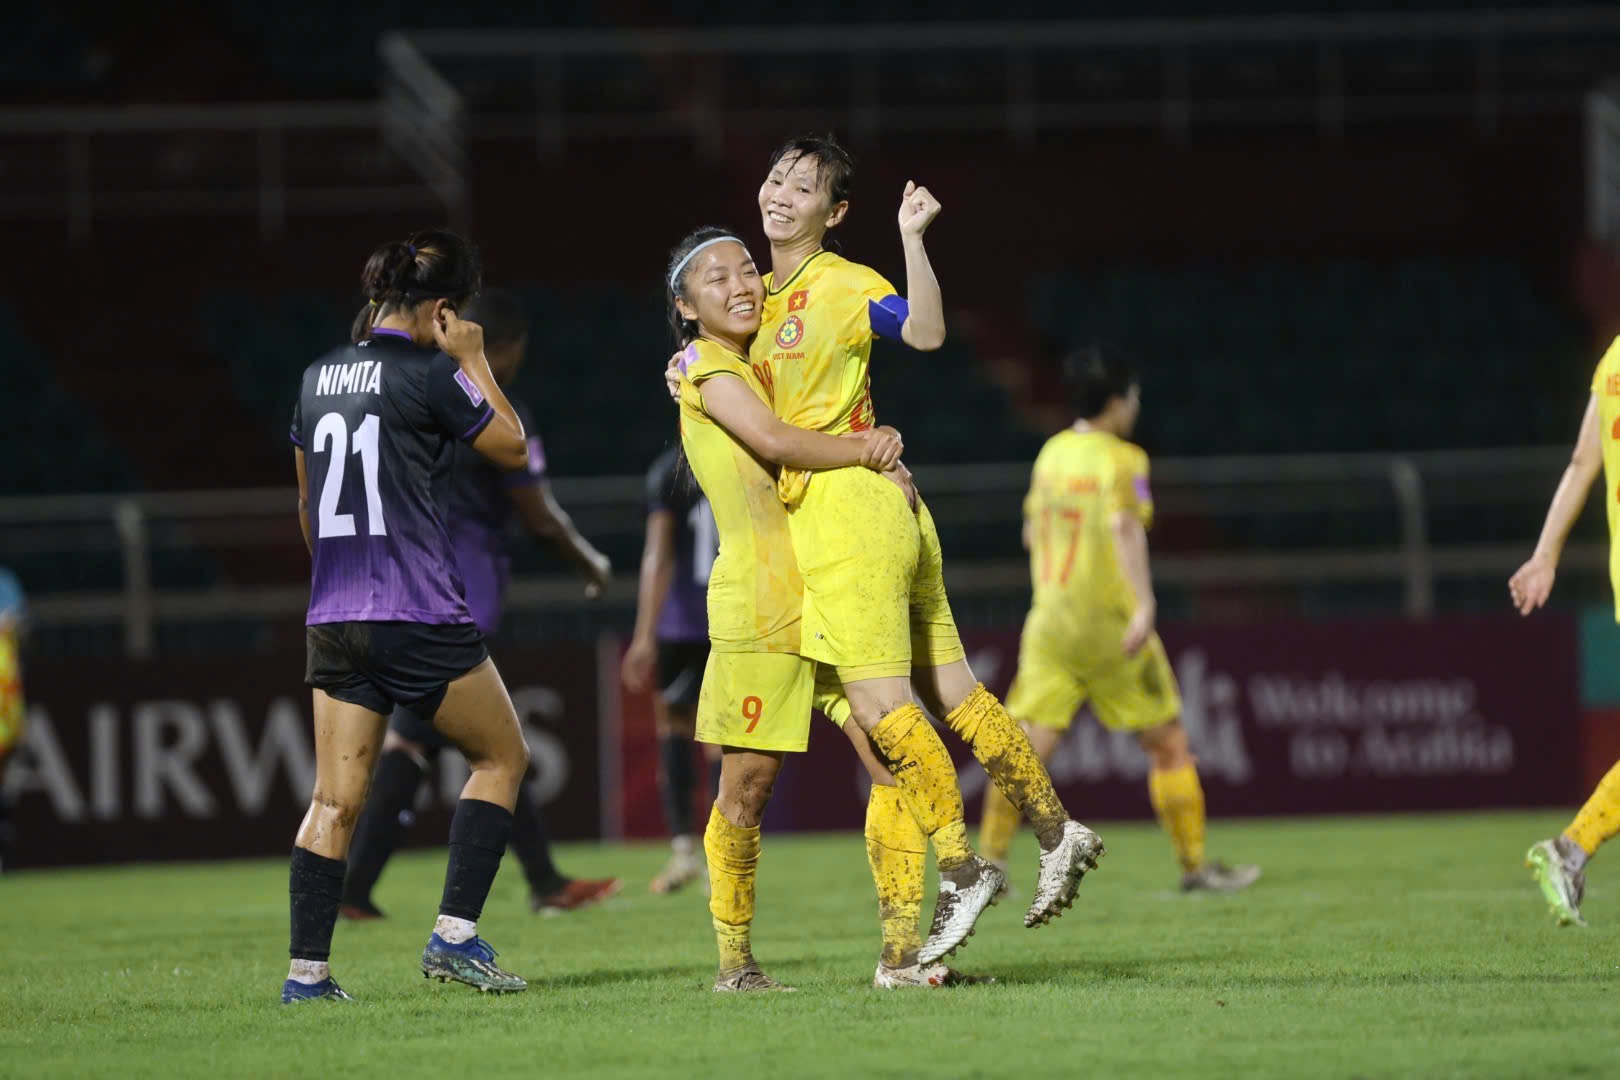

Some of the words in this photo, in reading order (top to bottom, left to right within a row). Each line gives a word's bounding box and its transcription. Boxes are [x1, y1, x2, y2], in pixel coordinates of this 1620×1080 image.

[315, 360, 383, 397] NIMITA
[312, 411, 388, 539] 21
[1040, 507, 1082, 588] 17
[1, 684, 569, 822] AIRWS
[741, 695, 763, 734] 9
